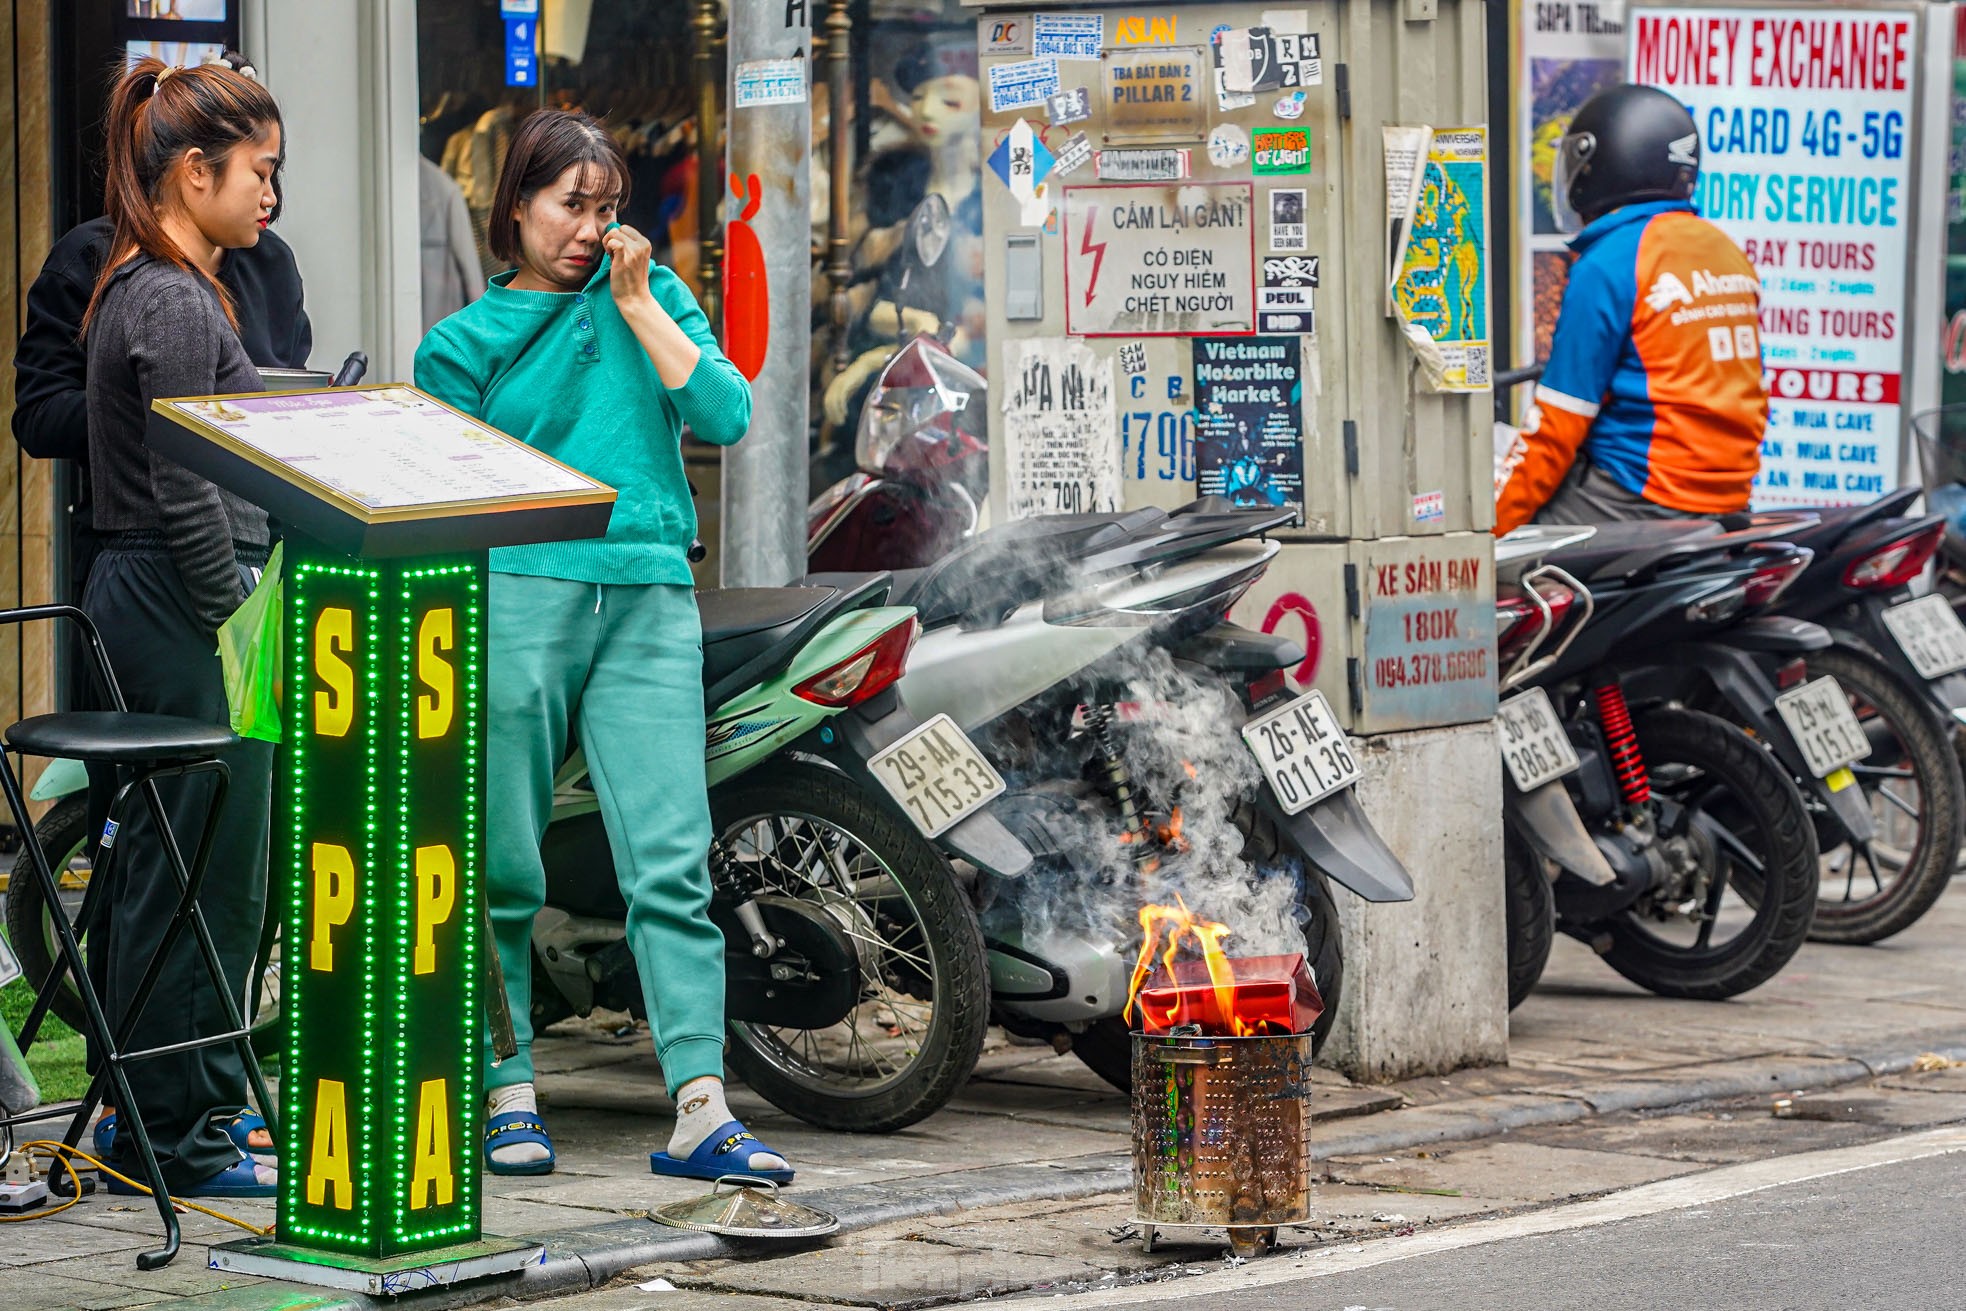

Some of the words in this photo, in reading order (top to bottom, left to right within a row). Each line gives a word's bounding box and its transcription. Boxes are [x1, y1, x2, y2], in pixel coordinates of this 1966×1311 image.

[1115, 14, 1178, 45] ASLAN
[1636, 17, 1740, 87] MONEY
[1751, 21, 1909, 91] EXCHANGE
[1113, 67, 1134, 80] TBA
[1184, 65, 1192, 78] 2
[1113, 84, 1176, 104] PILLAR
[1181, 83, 1193, 101] 2
[1707, 106, 1790, 154] CARD
[1765, 174, 1898, 226] SERVICE
[1143, 247, 1168, 266] CÓ
[1173, 248, 1213, 269] ĐIỆN
[1745, 239, 1788, 266] BAY
[1797, 240, 1876, 271] TOURS
[1132, 274, 1179, 289] NGUY
[1176, 291, 1233, 311] NGƯỜI
[1265, 292, 1305, 304] PEUL
[1819, 310, 1896, 340] TOURS
[1120, 342, 1142, 355] SAM
[1205, 342, 1286, 360] Vietnam
[1197, 363, 1296, 381] Motorbike
[1212, 385, 1281, 403] Market
[1835, 412, 1873, 431] CAVE
[1839, 445, 1877, 464] CAVE
[1845, 474, 1883, 493] CAVE
[1376, 563, 1398, 597] XE
[1405, 555, 1441, 594] SÂN
[1448, 558, 1480, 592] BAY
[1403, 608, 1460, 643] 180K
[1260, 703, 1328, 763] 26-AE
[885, 728, 961, 790] 29-AA
[1276, 740, 1354, 804] 011.36
[906, 757, 995, 831] 715.33
